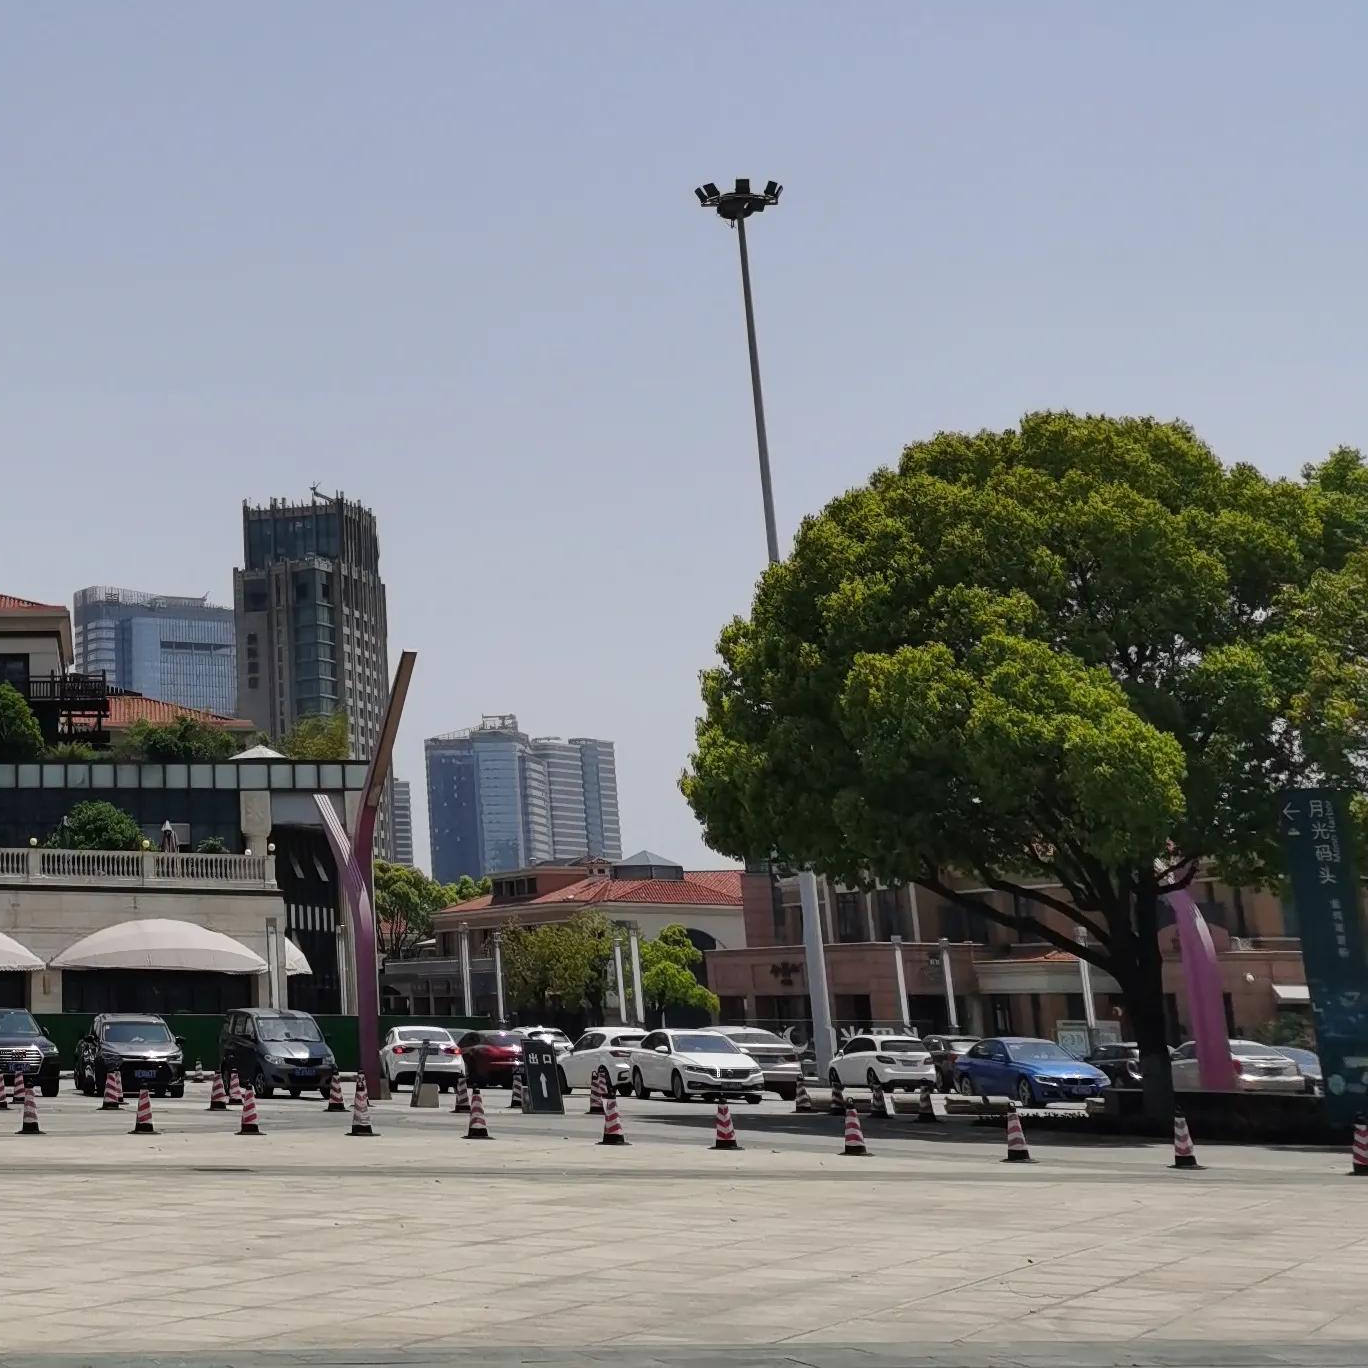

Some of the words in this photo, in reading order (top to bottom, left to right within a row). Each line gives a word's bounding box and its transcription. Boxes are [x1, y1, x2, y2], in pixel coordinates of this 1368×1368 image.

[1309, 800, 1336, 884] 月光码头
[528, 1053, 552, 1065] 出口
